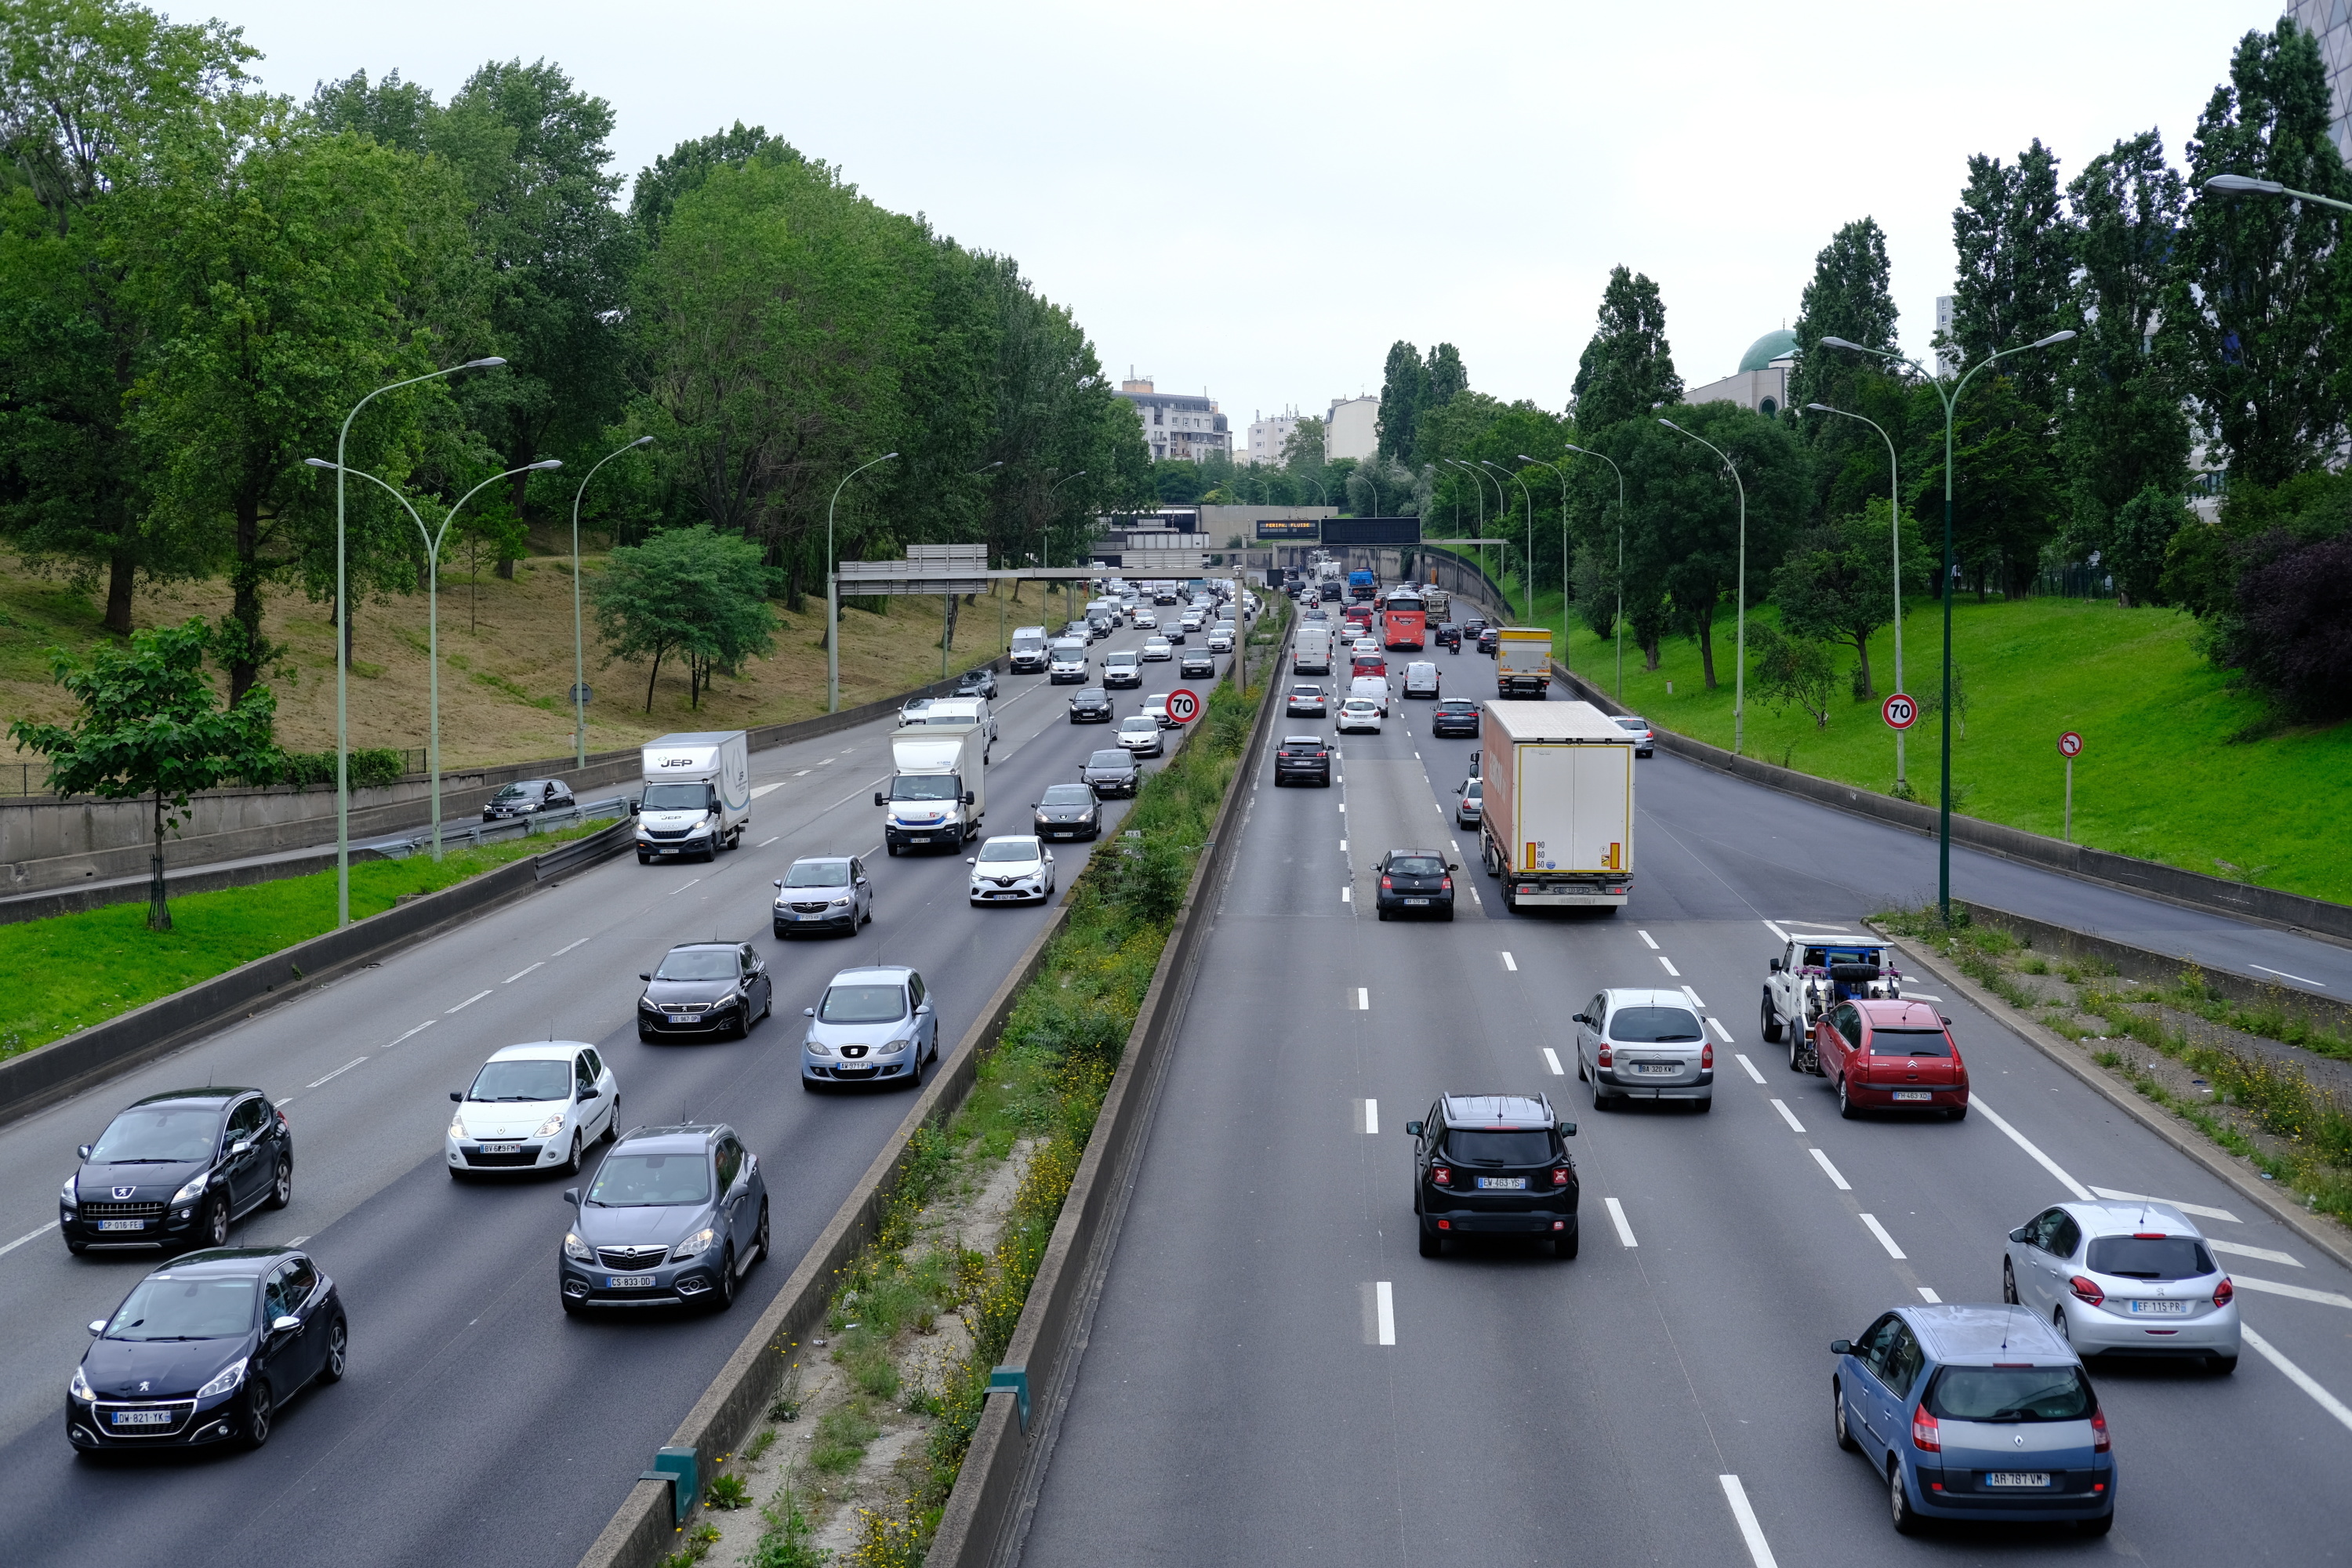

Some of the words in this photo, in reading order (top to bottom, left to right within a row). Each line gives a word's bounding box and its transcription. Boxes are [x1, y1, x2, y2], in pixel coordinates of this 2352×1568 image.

[1173, 699, 1193, 713] 70
[1890, 704, 1911, 719] 70
[660, 759, 693, 768] JEP
[612, 1277, 650, 1286] CS-833-DD
[2138, 1302, 2180, 1312] EF-115-PR
[119, 1413, 164, 1423] DW-821-YK
[1994, 1473, 2043, 1484] AR-787-VM
